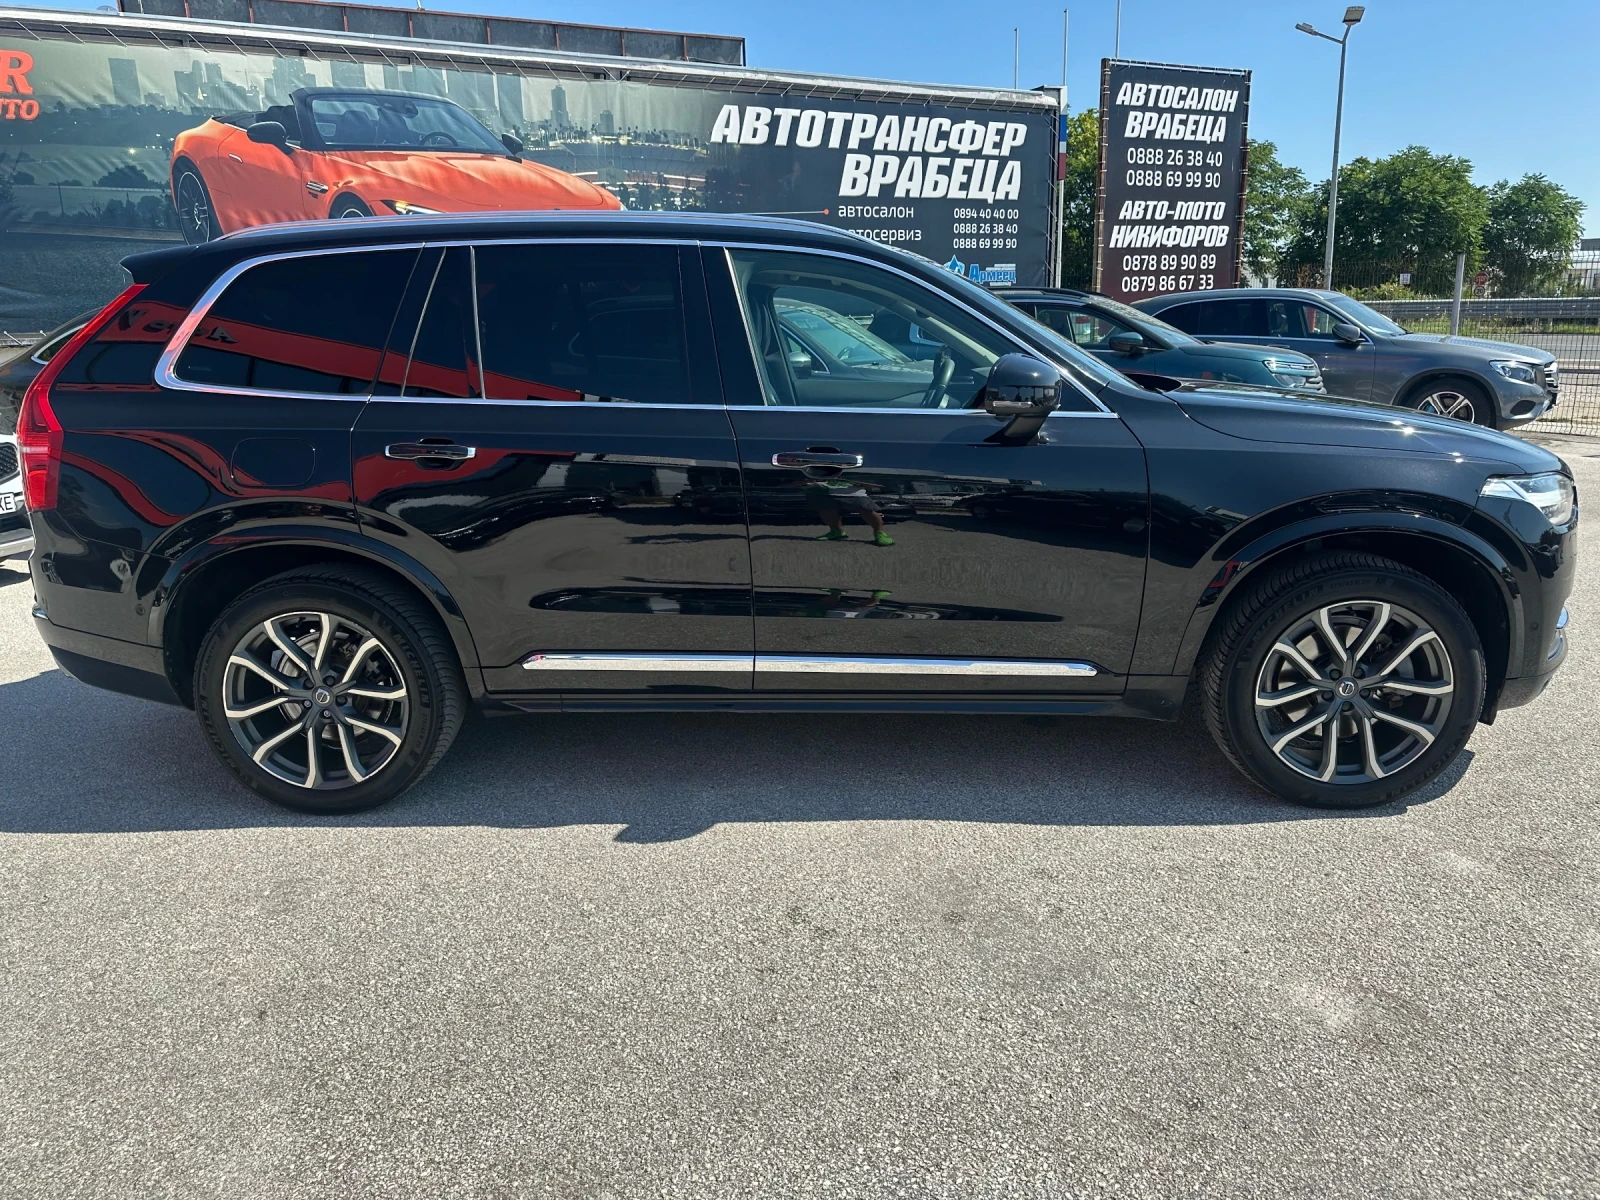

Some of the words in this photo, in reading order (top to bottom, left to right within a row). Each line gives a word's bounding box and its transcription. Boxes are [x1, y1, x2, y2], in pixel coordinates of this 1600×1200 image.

[1116, 82, 1239, 112] АВТОСАЛОН
[710, 104, 1028, 157] АВТОТРАНСФЕР
[1124, 111, 1227, 144] ВРАБЕЦА
[1127, 147, 1163, 165] 0888
[1167, 149, 1184, 166] 26
[1186, 150, 1203, 167] 38
[1206, 151, 1223, 167] 40
[838, 153, 1022, 204] ВРАБЕЦА
[1126, 170, 1162, 187] 0888
[1166, 171, 1182, 187] 69
[1186, 172, 1202, 188] 99
[1205, 172, 1221, 189] 90
[838, 205, 915, 219] автосалон
[953, 208, 978, 219] 0894
[979, 208, 992, 219] 40
[993, 208, 1005, 219] 40
[1006, 208, 1019, 219] 00
[1118, 200, 1226, 221] АВТО-МОТО
[953, 223, 978, 234] 0888
[979, 223, 991, 234] 26
[992, 223, 1004, 234] 38
[1005, 223, 1018, 234] 40
[1109, 225, 1230, 248] НИКИФОРОВ
[953, 238, 978, 249] 0888
[979, 238, 991, 249] 69
[991, 238, 1004, 249] 99
[1005, 238, 1018, 249] 90
[1122, 254, 1157, 271] 0878
[1160, 254, 1177, 271] 89
[1180, 254, 1197, 270] 90
[1200, 254, 1216, 270] 89
[969, 263, 1017, 284] Армеец
[1121, 276, 1156, 293] 0879
[1159, 275, 1176, 292] 86
[1179, 275, 1195, 291] 67
[1198, 274, 1214, 290] 33
[1254, 586, 1320, 642] MICHELIN
[393, 634, 431, 704] MICHELIN
[200, 698, 238, 770] MICHELIN
[1391, 743, 1456, 799] MICHELIN
